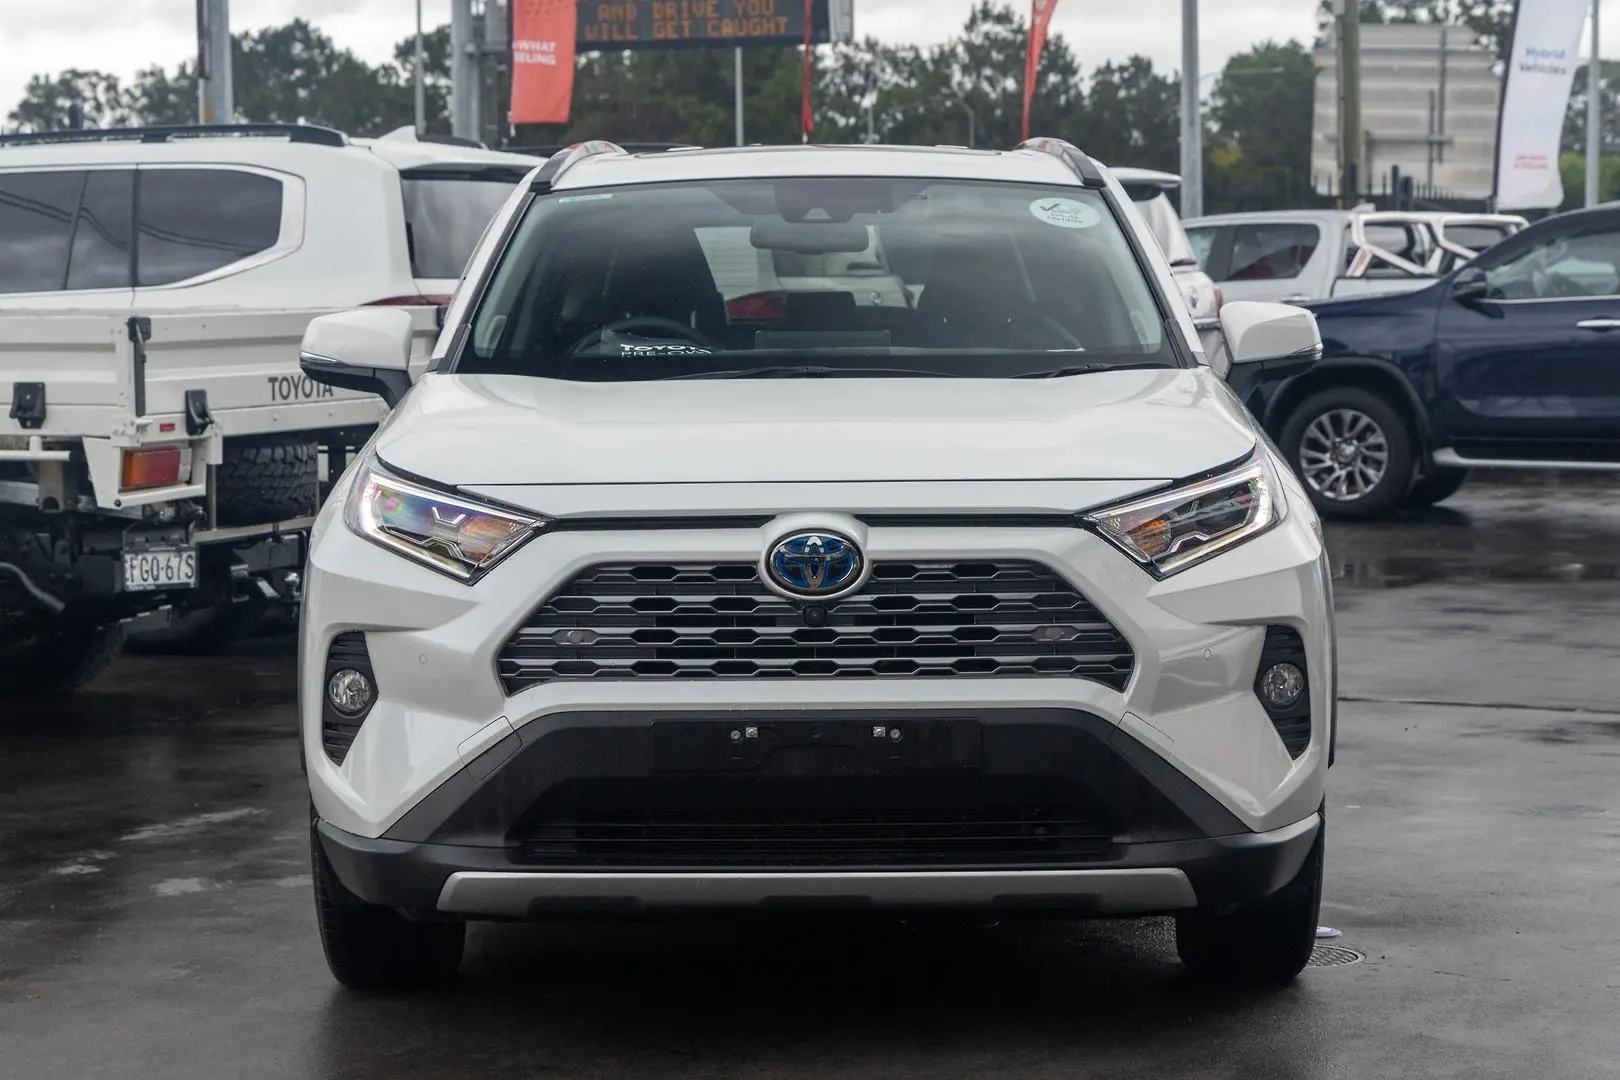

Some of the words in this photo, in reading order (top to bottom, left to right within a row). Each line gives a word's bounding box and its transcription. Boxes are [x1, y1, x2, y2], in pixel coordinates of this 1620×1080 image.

[597, 4, 637, 21] AND
[652, 0, 720, 19] DRIVE
[735, 0, 774, 16] YOU
[585, 22, 638, 41] WILL
[653, 20, 690, 38] GET
[706, 16, 788, 37] CAUGHT
[1525, 46, 1566, 60] Hybrid
[1519, 62, 1567, 76] Vehicles
